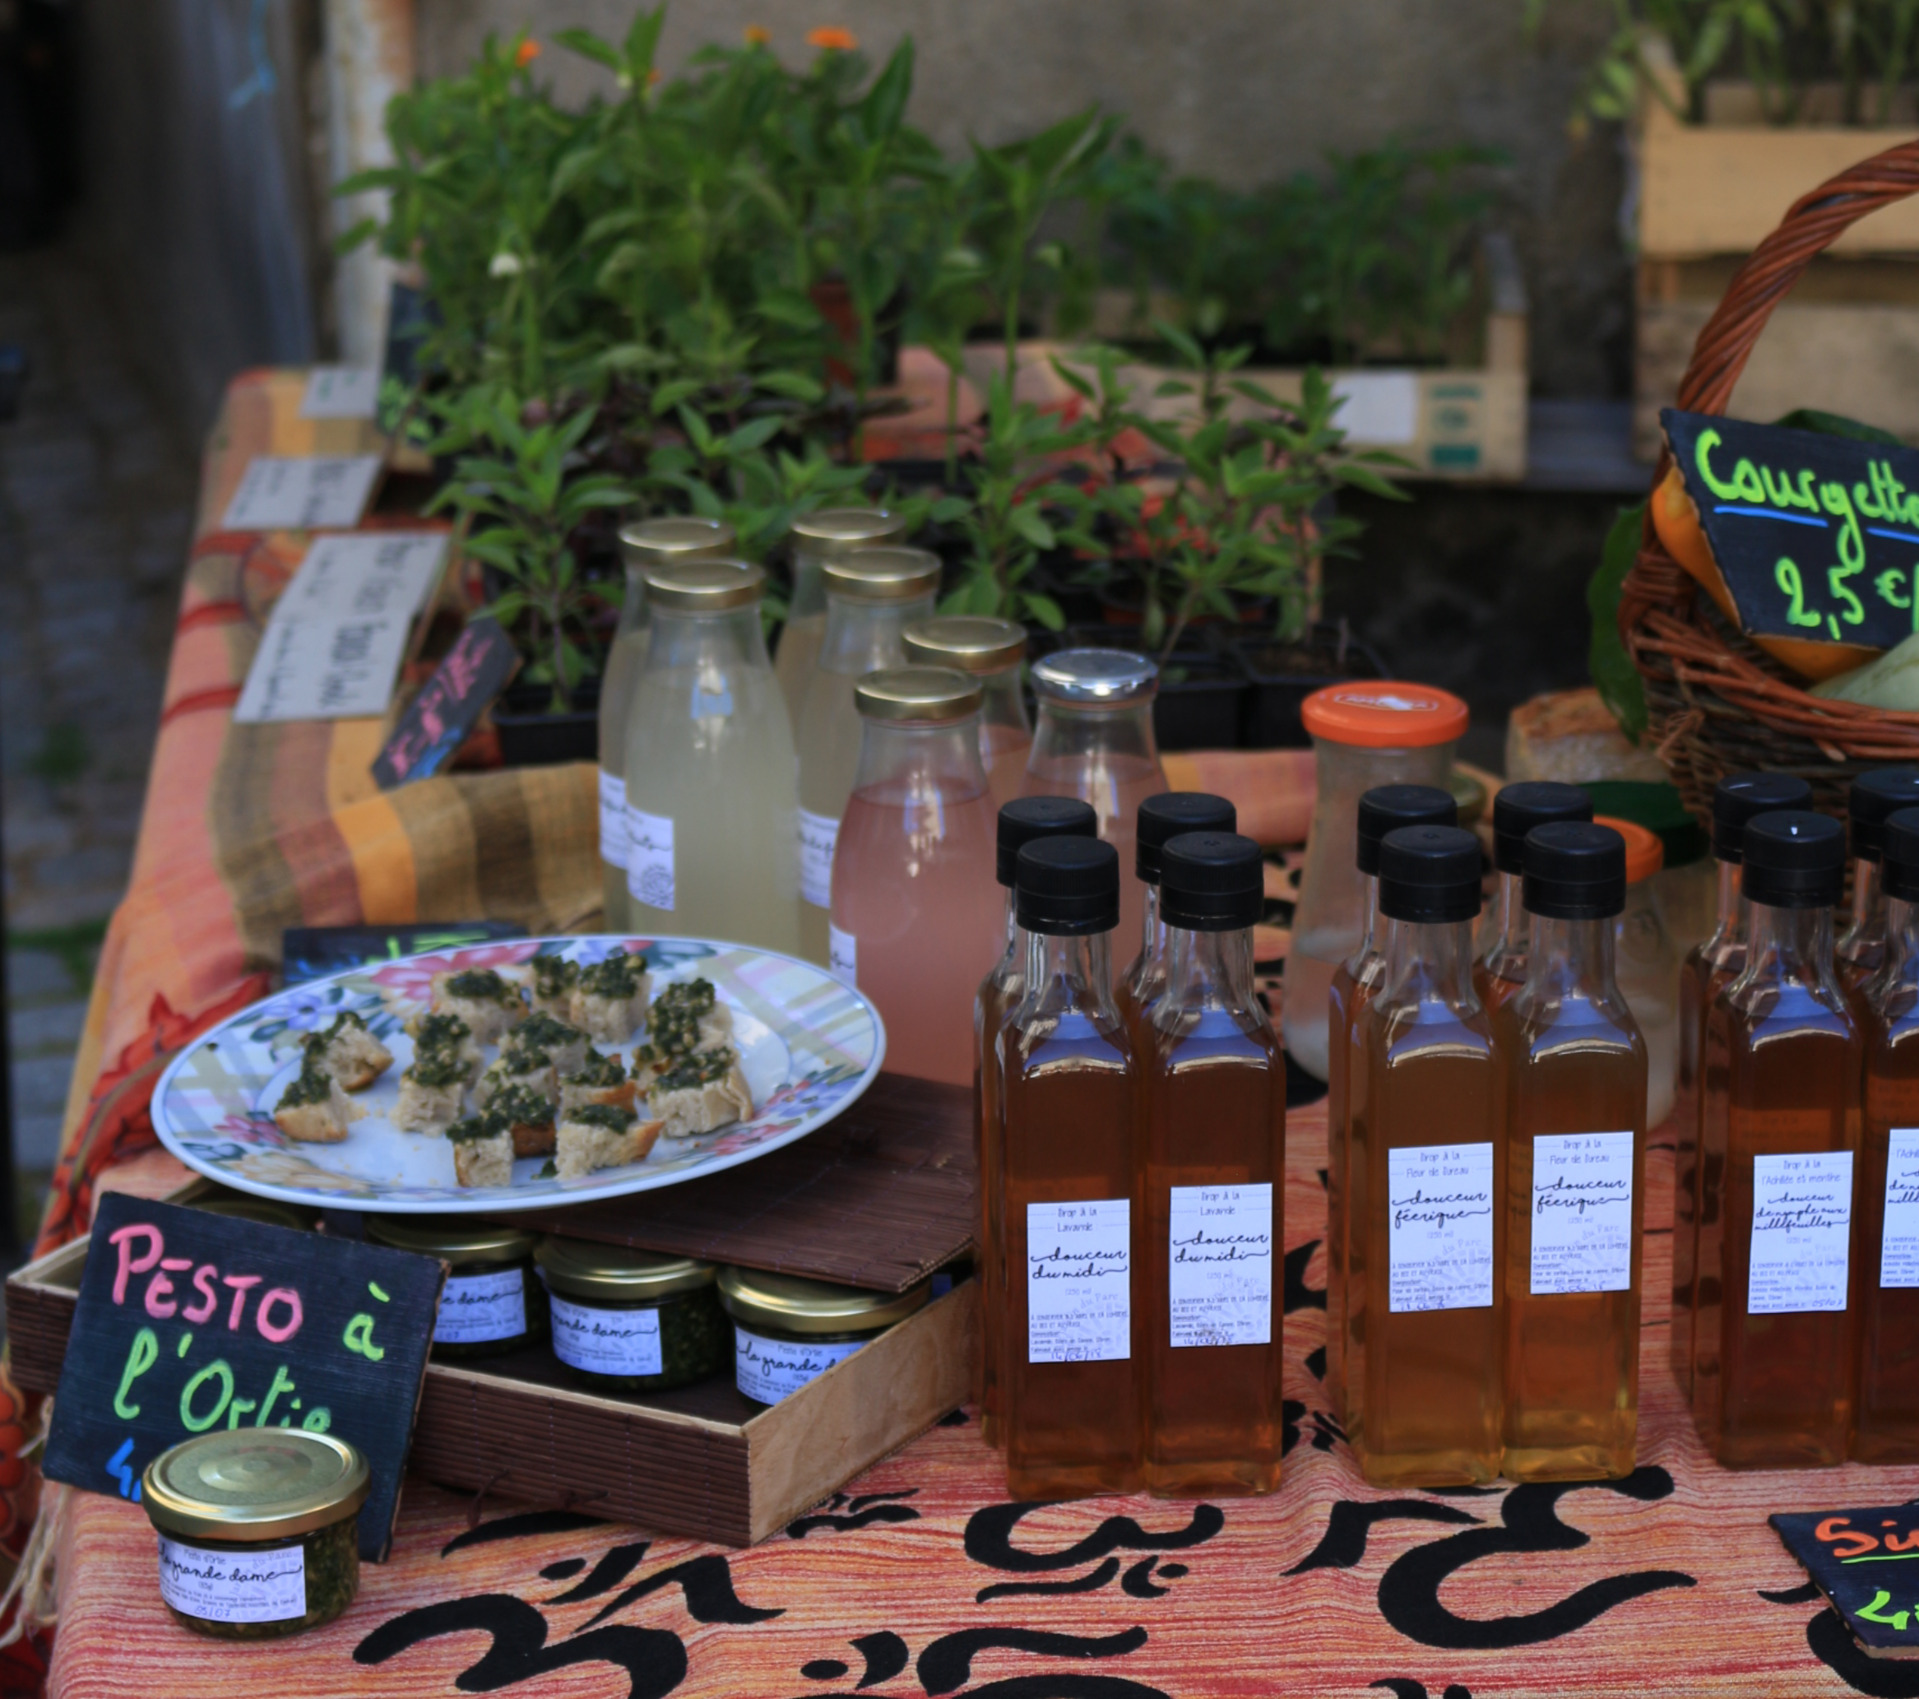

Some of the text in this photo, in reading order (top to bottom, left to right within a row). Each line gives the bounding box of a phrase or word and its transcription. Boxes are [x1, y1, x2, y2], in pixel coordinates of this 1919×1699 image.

[1535, 1176, 1627, 1191] douceur
[1392, 1189, 1487, 1206] douceur
[1767, 1192, 1834, 1204] douceur
[1172, 1230, 1269, 1246] douceur
[1030, 1246, 1127, 1263] douceur
[108, 1223, 304, 1343] PESTO
[343, 1280, 391, 1362] à
[762, 1358, 823, 1377] grande
[172, 1560, 226, 1582] grande
[228, 1565, 303, 1583] dame
